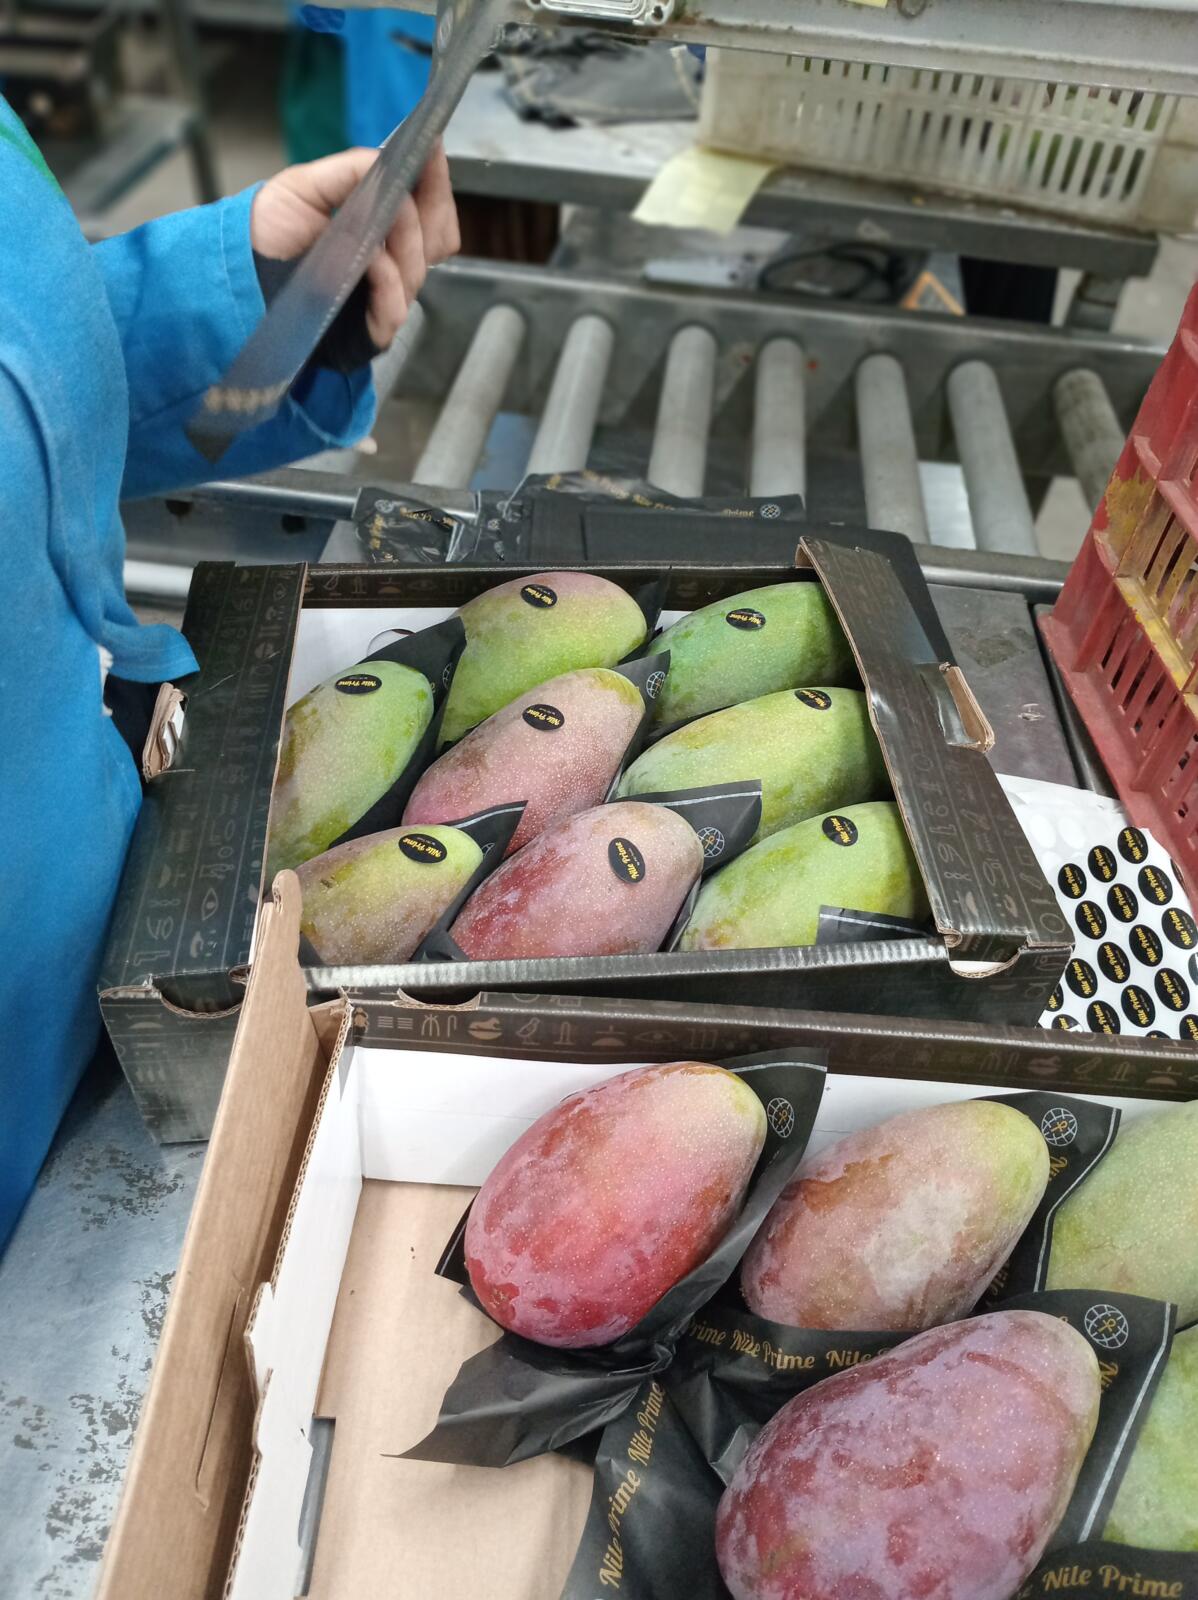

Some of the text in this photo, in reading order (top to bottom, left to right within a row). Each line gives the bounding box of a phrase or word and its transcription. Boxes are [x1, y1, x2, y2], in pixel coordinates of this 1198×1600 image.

[527, 709, 545, 720] Prime
[546, 716, 561, 726] Nile
[402, 838, 426, 851] Prime
[426, 847, 442, 858] Nile
[615, 842, 630, 864] Prime
[627, 863, 639, 880] Nile
[1144, 868, 1159, 888] Prime
[1155, 887, 1167, 902] Nile
[1169, 910, 1184, 931] Prime
[1135, 927, 1149, 948] Prime
[1180, 930, 1192, 946] Nile
[1146, 947, 1158, 963] Nile
[1072, 961, 1085, 981] Prime
[1081, 980, 1092, 995] Nile
[1160, 972, 1175, 993] Prime
[1127, 989, 1141, 1010] Prime
[1172, 993, 1183, 1008] Nile
[1138, 1009, 1149, 1025] Nile
[730, 1329, 761, 1358] Nile
[762, 1340, 816, 1371] Prime
[826, 1350, 873, 1368] Nile
[636, 1382, 666, 1433] Prime
[627, 1429, 654, 1466] Nile
[599, 1536, 624, 1589] Nile
[1042, 1564, 1184, 1599] Nile Prime
